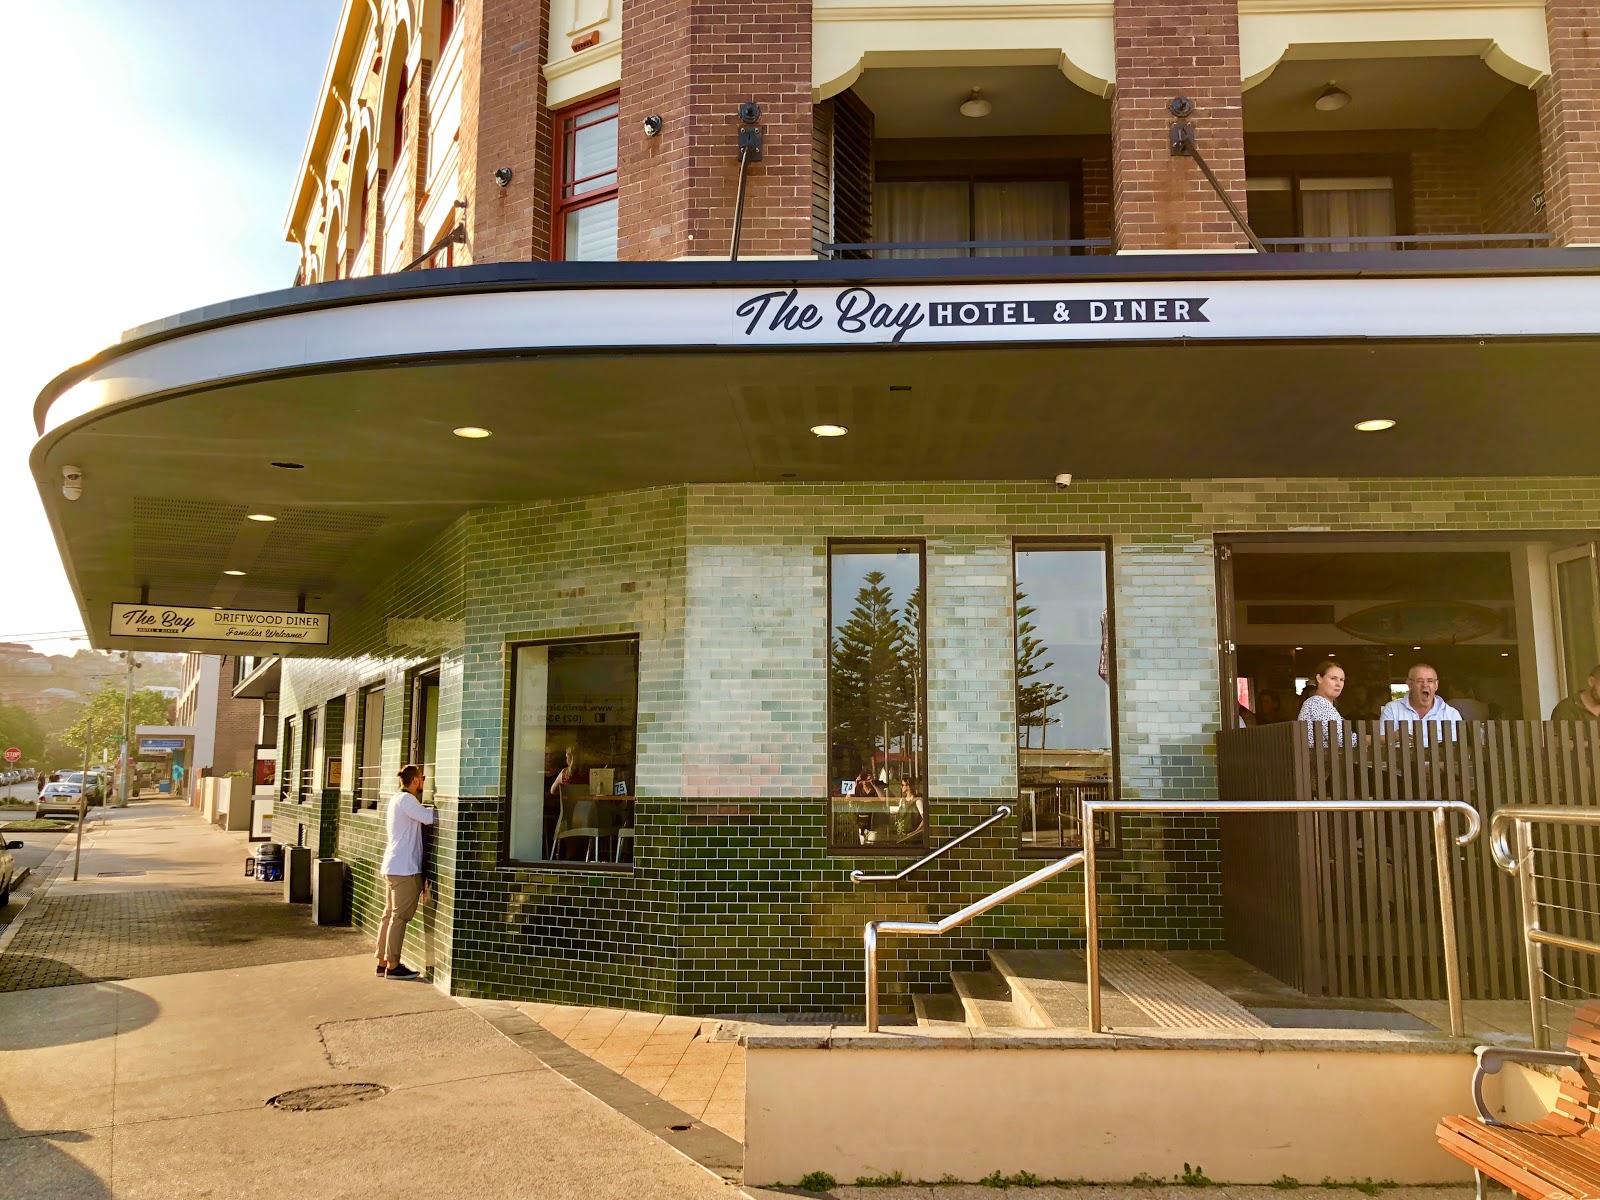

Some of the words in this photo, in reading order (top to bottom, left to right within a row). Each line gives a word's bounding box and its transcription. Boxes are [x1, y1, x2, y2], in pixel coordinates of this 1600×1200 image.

[736, 288, 823, 335] The
[835, 287, 925, 343] Bay
[937, 303, 1035, 324] HOTEL
[1053, 302, 1070, 322] &
[1090, 300, 1191, 322] DINER
[122, 609, 157, 625] The
[161, 610, 195, 633] Bay
[214, 612, 283, 625] DRIFTWOOD
[286, 616, 319, 626] DINER
[225, 627, 262, 637] Families
[265, 628, 308, 639] Welcome!
[615, 783, 625, 793] 75
